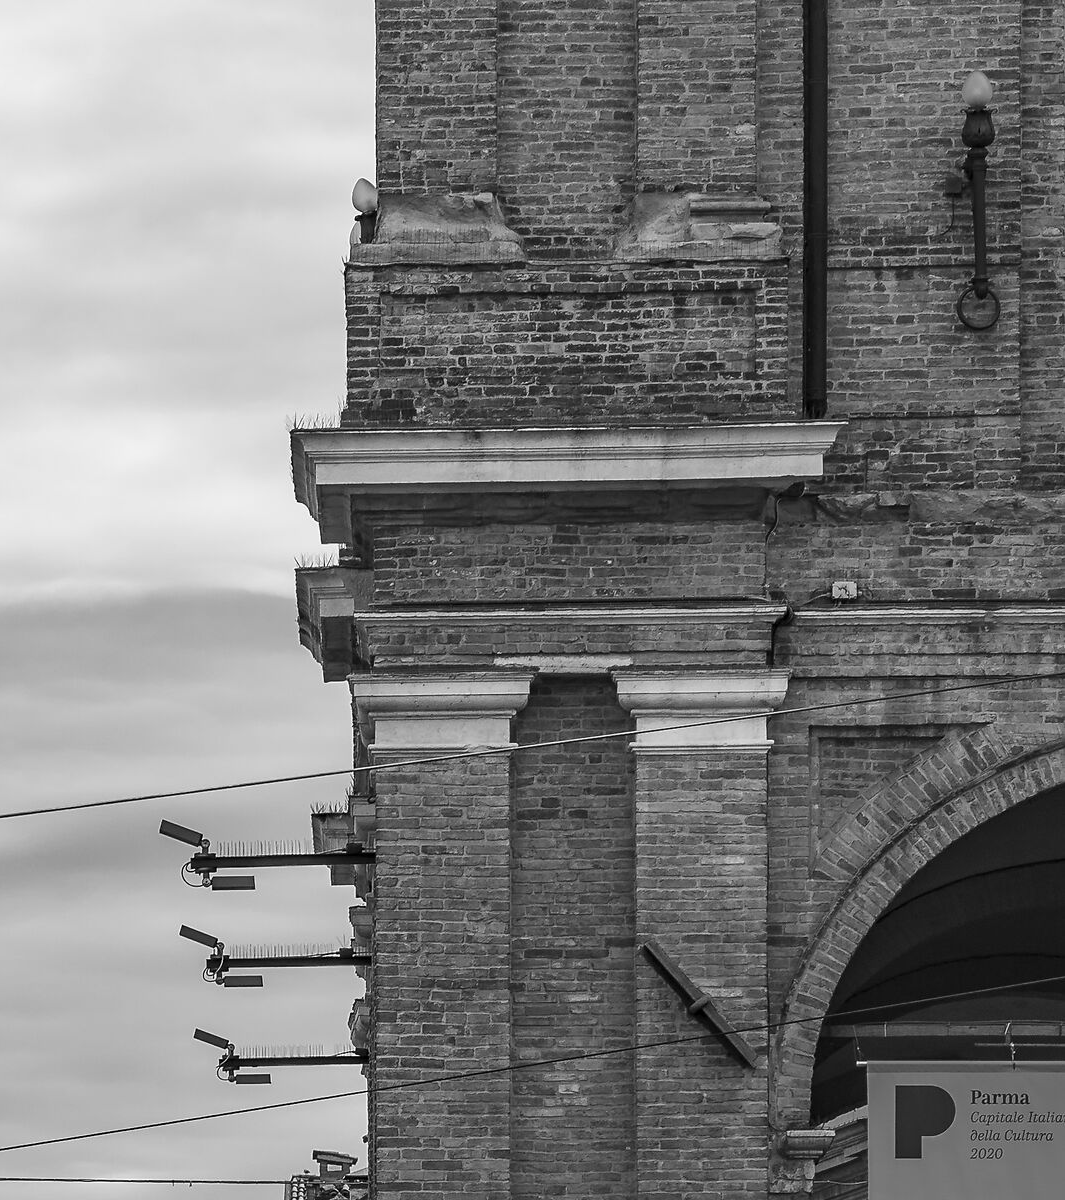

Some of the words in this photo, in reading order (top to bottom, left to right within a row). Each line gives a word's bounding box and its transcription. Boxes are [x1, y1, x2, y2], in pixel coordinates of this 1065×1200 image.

[970, 1089, 1030, 1105] Parma
[970, 1111, 1024, 1126] Capitale
[1004, 1129, 1054, 1142] Cultura
[970, 1147, 1004, 1160] 2020
